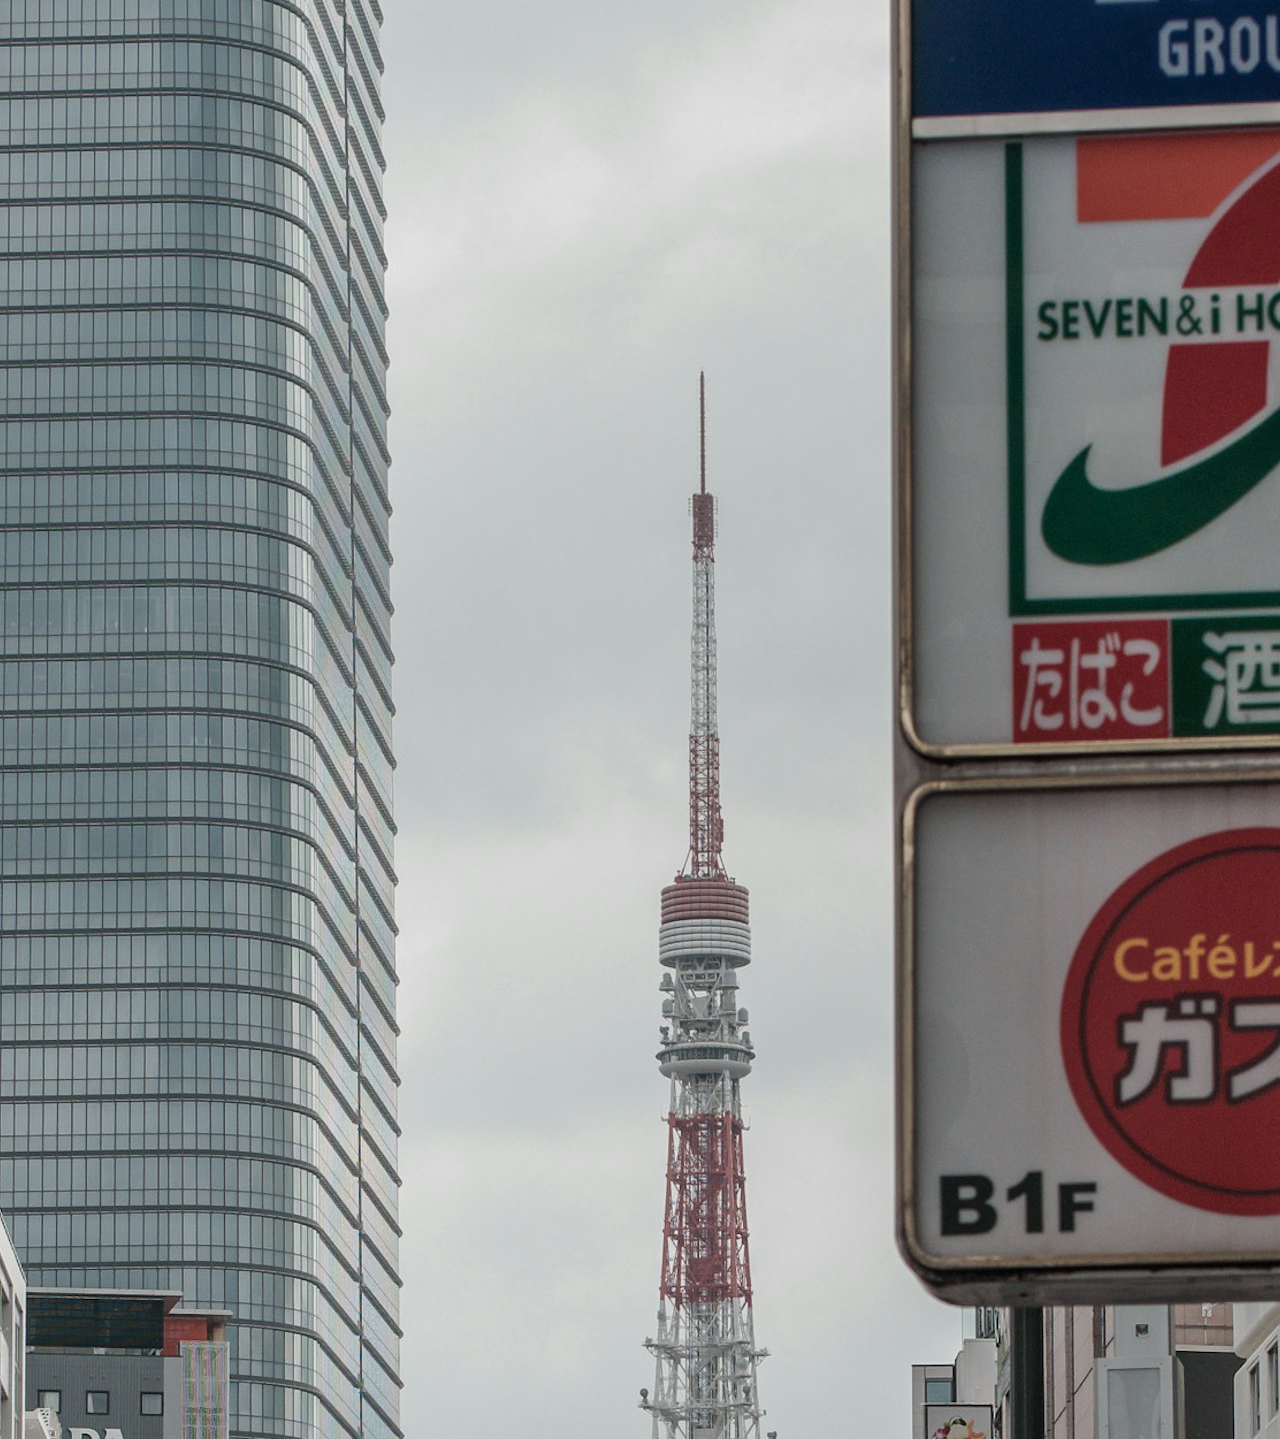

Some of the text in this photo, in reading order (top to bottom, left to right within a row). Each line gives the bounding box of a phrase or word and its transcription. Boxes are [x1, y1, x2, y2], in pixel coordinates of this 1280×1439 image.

[1019, 632, 1164, 731] たばこ
[939, 1171, 1098, 1237] B1F
